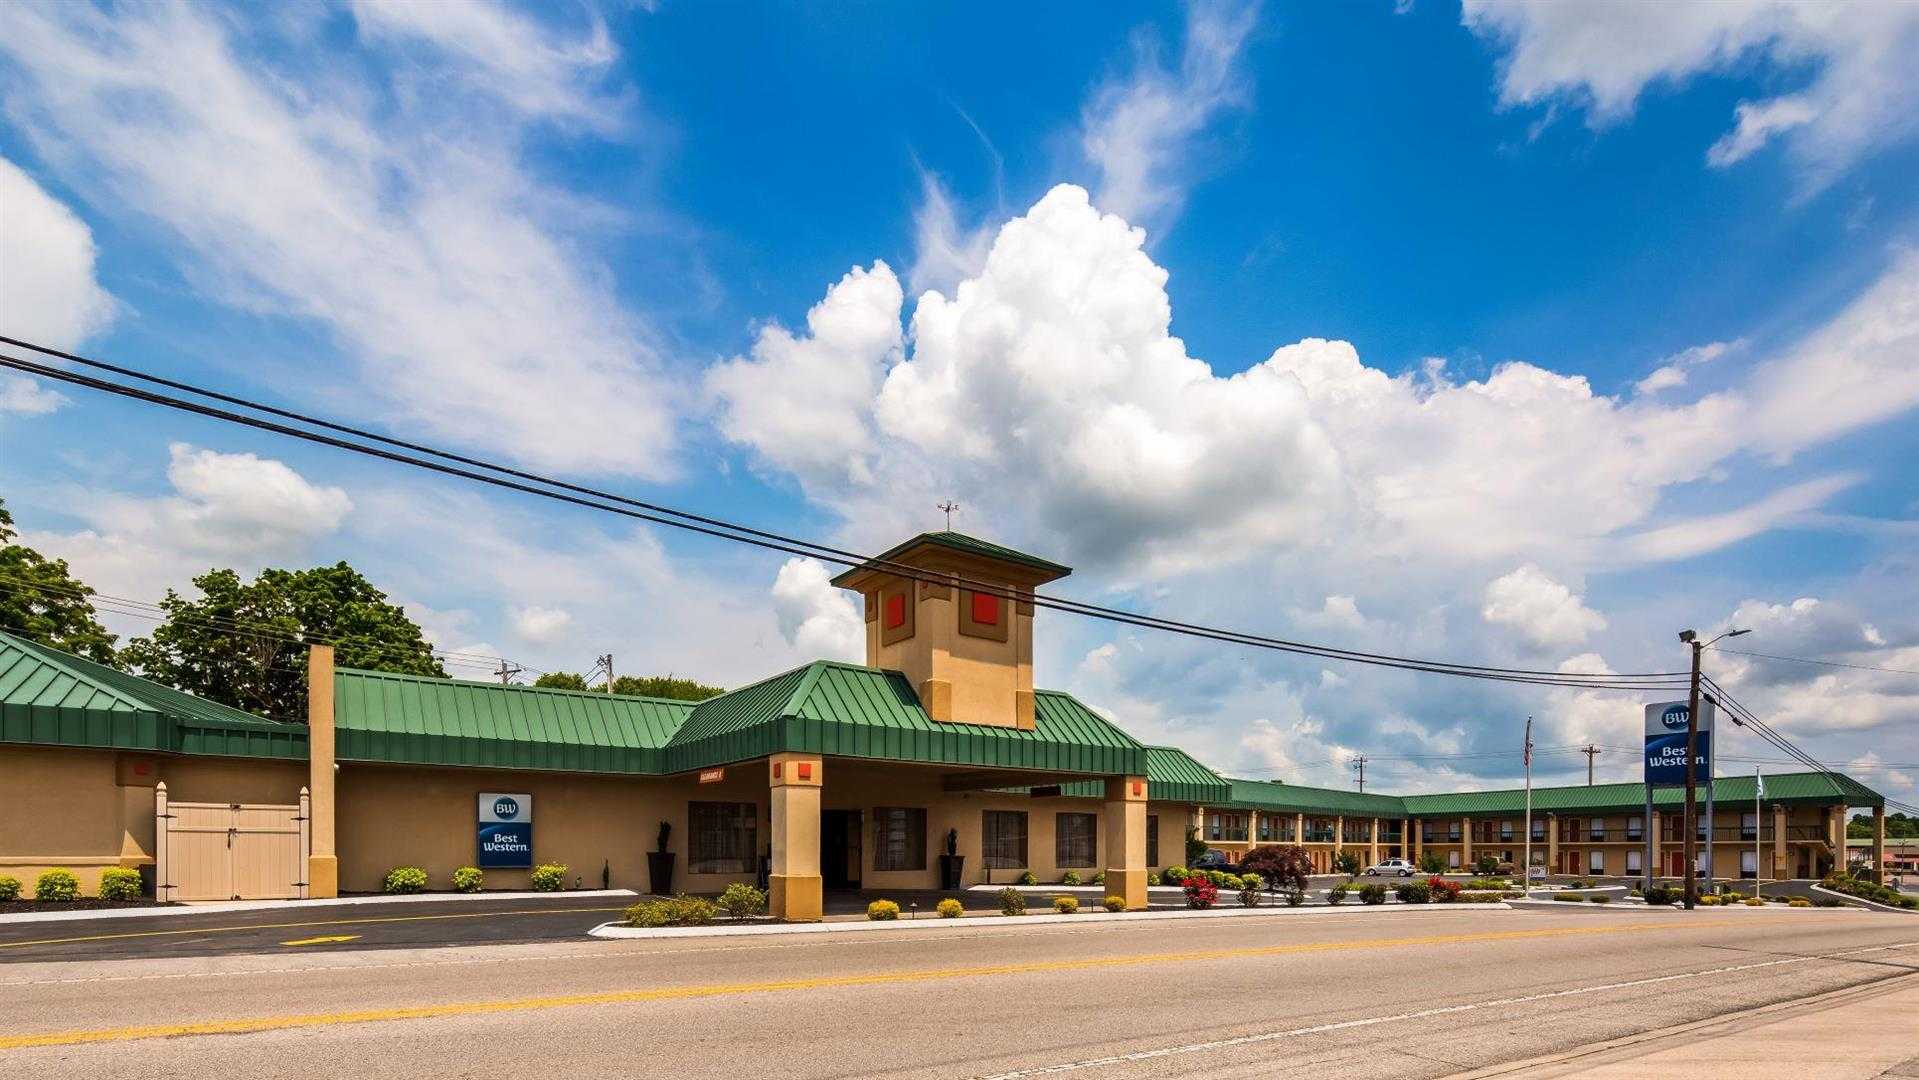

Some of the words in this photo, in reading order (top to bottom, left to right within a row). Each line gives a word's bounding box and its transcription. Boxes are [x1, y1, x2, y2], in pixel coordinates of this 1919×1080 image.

[1665, 711, 1689, 724] BW
[1662, 746, 1688, 757] Bes
[1649, 756, 1705, 767] Westen
[496, 803, 516, 814] BW
[494, 833, 518, 843] Best
[483, 842, 527, 852] Western
